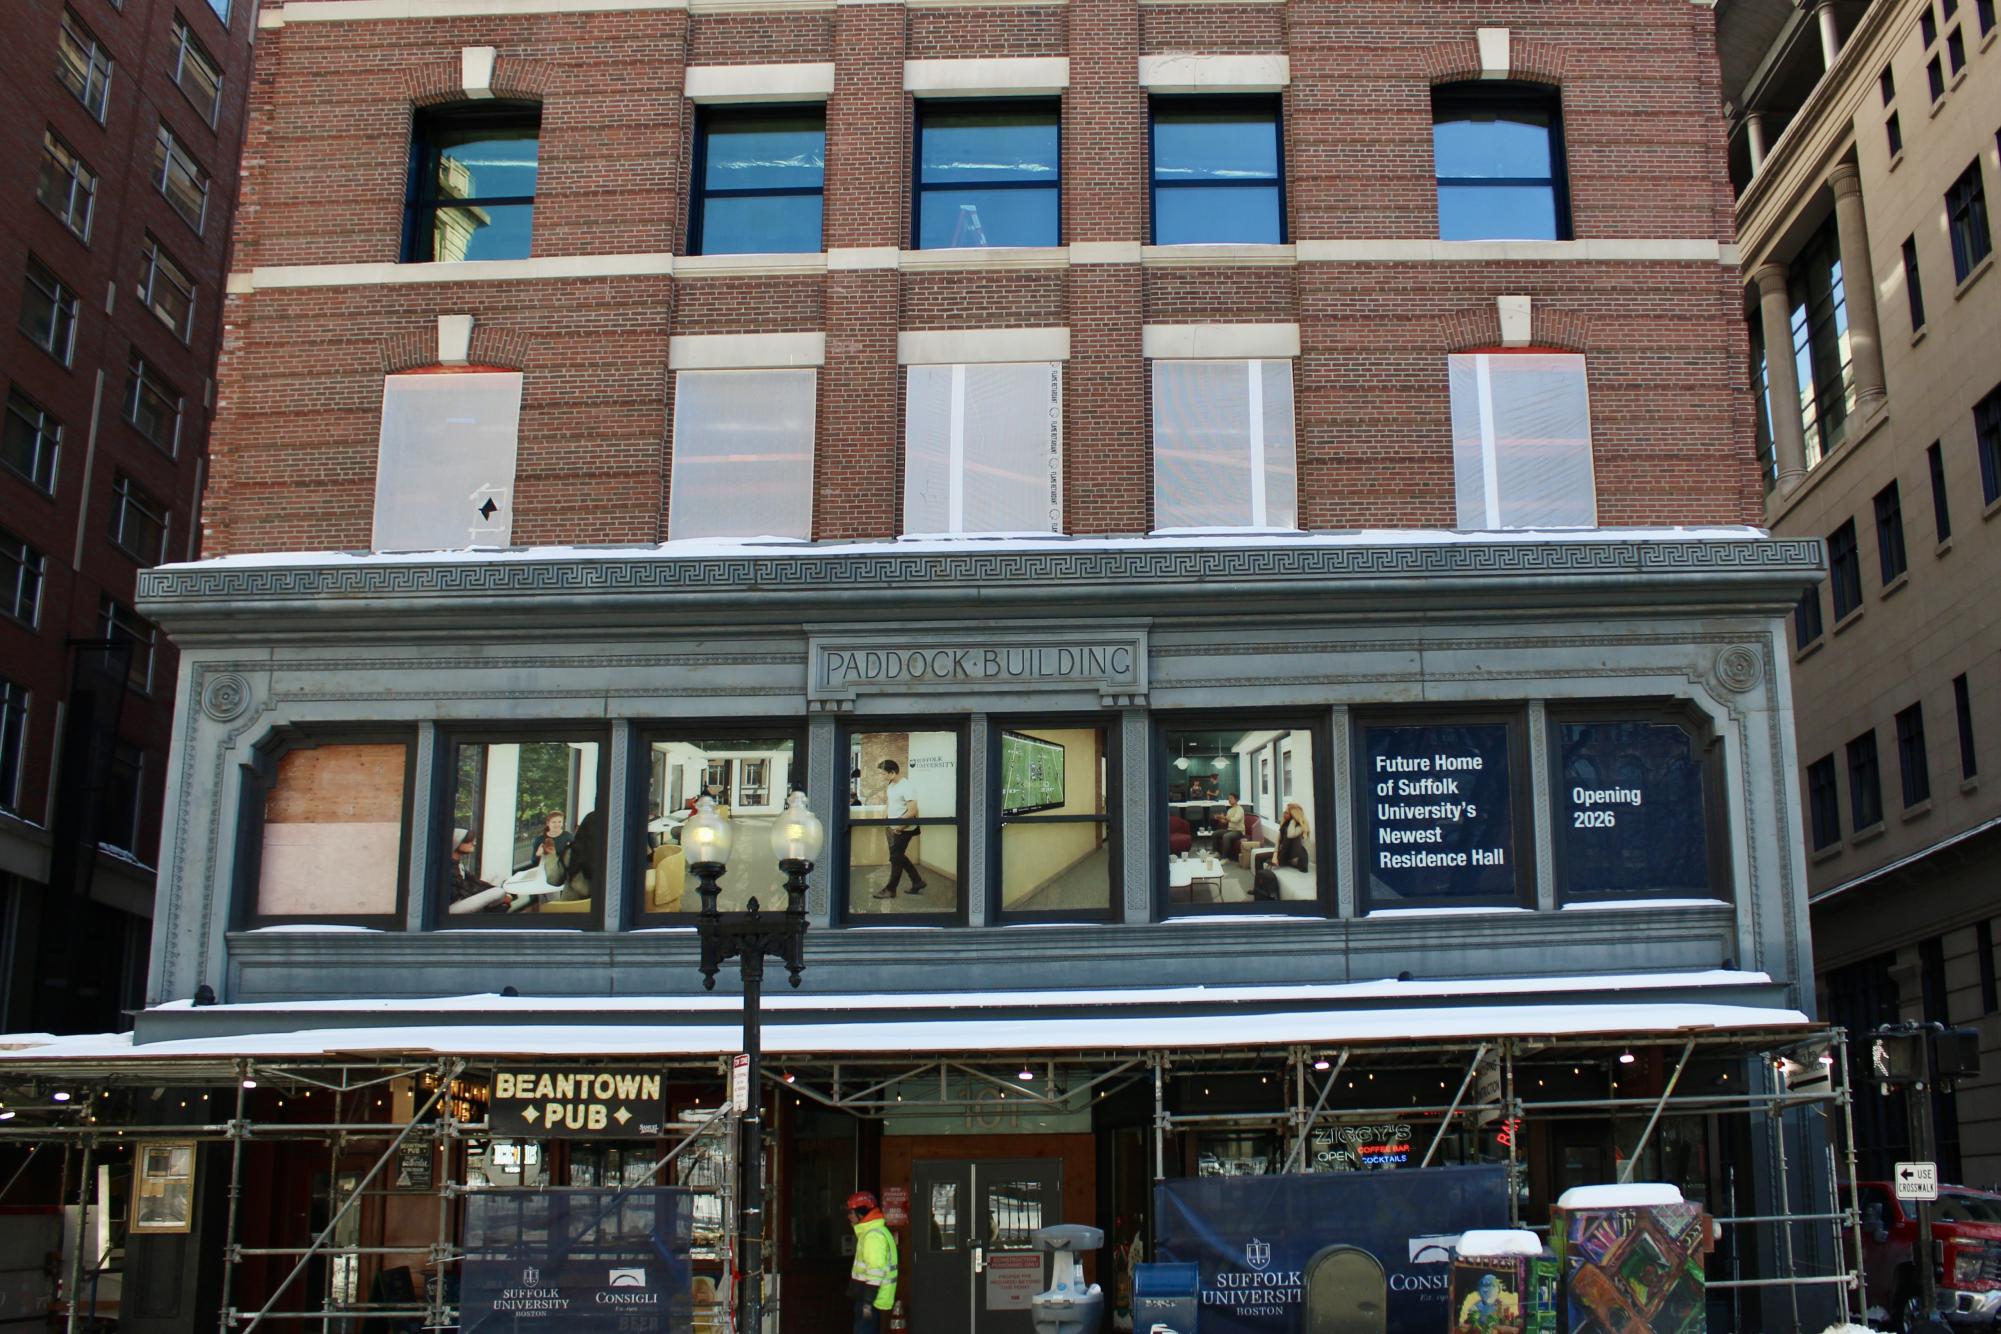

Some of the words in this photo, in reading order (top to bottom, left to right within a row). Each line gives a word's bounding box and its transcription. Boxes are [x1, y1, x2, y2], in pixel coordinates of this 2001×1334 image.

[826, 650, 970, 686] PADDOCK
[984, 647, 1130, 677] BUILDING
[1376, 756, 1430, 772] Future
[1434, 754, 1483, 770] Home
[1377, 779, 1394, 796] of
[1398, 778, 1459, 796] Suffolk
[1572, 787, 1641, 807] Opening
[1378, 801, 1477, 821] University's
[1573, 811, 1615, 828] 2026
[1379, 826, 1442, 844] Newest
[1380, 850, 1467, 868] Residence
[1471, 848, 1504, 865] Hall
[495, 1073, 661, 1100] BEANTOWN
[544, 1103, 608, 1129] PUB
[1314, 1123, 1412, 1145] ZIGGY'S
[1318, 1151, 1355, 1162] OPEN
[1357, 1145, 1391, 1154] COFFEE
[1393, 1144, 1410, 1152] BAR
[1362, 1154, 1407, 1164] COCKTAILS
[1917, 1169, 1932, 1179] USE
[1899, 1183, 1935, 1193] CROSSWALK
[1217, 1272, 1301, 1288] SUFFOLK
[1389, 1273, 1449, 1291] CONSI
[503, 1288, 560, 1299] SUFFOLK
[1202, 1289, 1301, 1305] UNIVERSIT
[493, 1299, 569, 1310] UNIVERSITY
[1237, 1306, 1283, 1316] BOSTON
